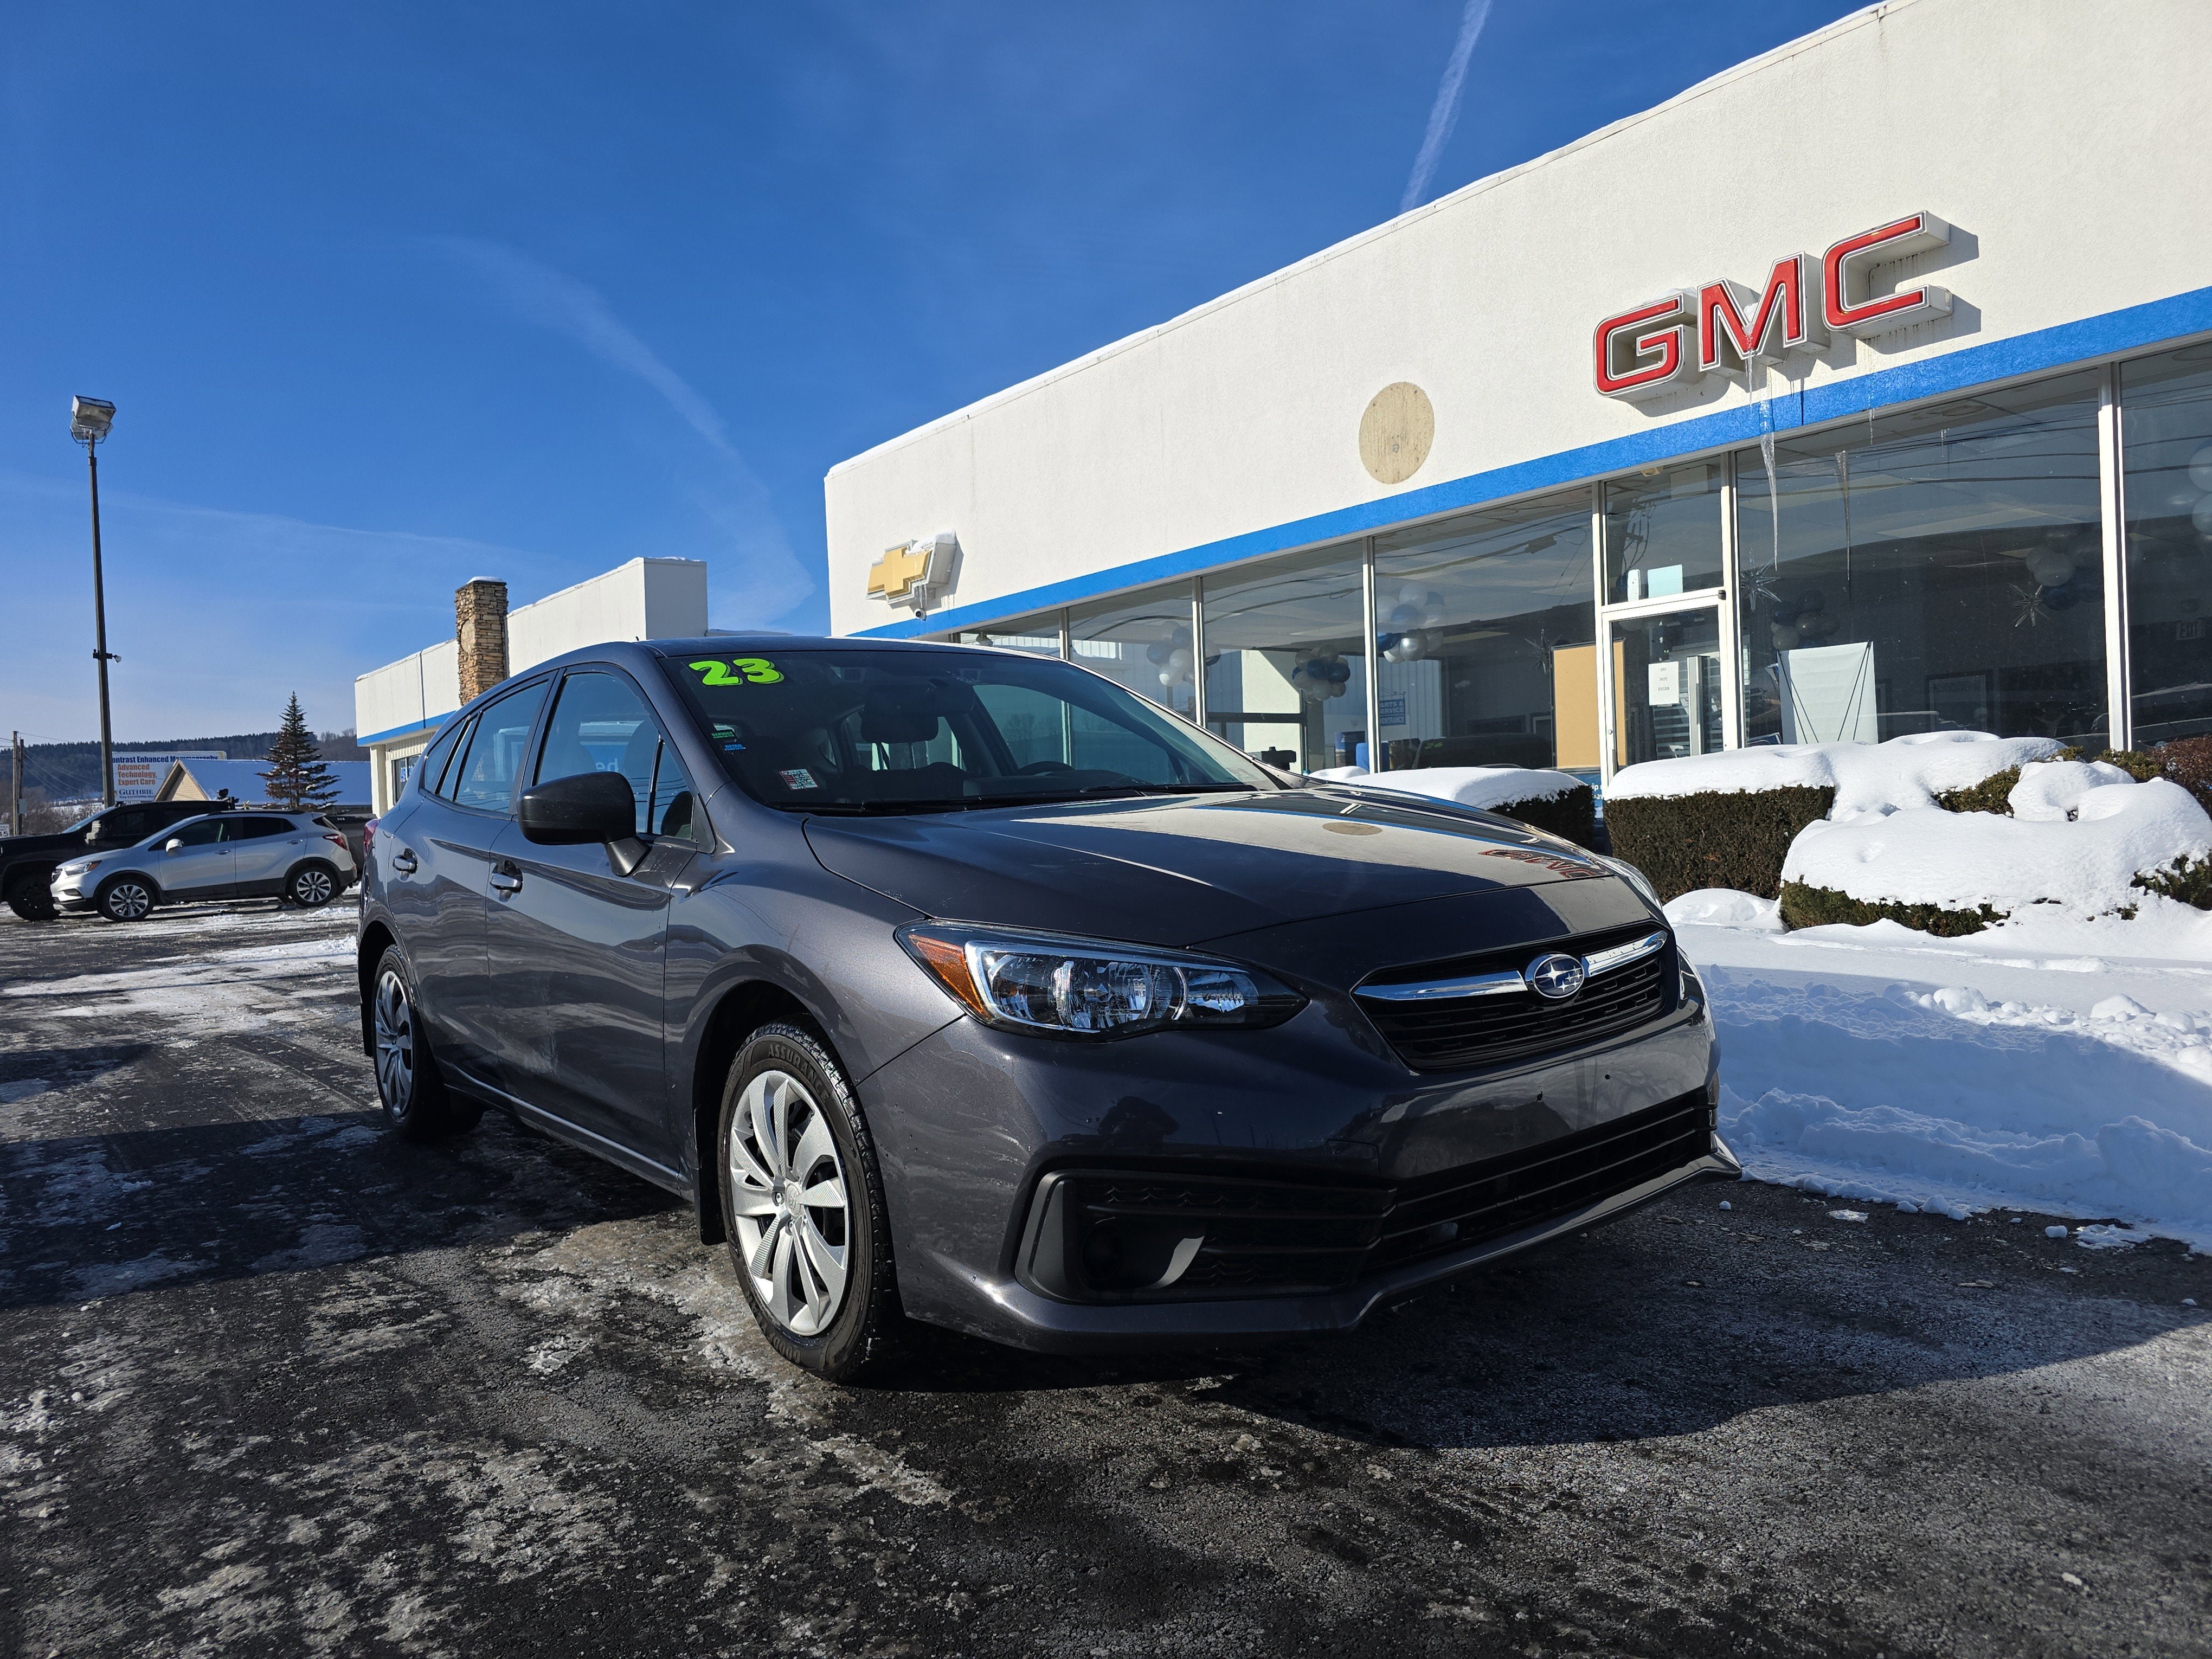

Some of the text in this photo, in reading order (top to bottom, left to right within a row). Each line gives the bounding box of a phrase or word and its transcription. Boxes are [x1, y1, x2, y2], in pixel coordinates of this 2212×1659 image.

[1593, 210, 1929, 397] GMC
[689, 658, 785, 686] 23
[768, 1043, 830, 1103] ASSURANCE
